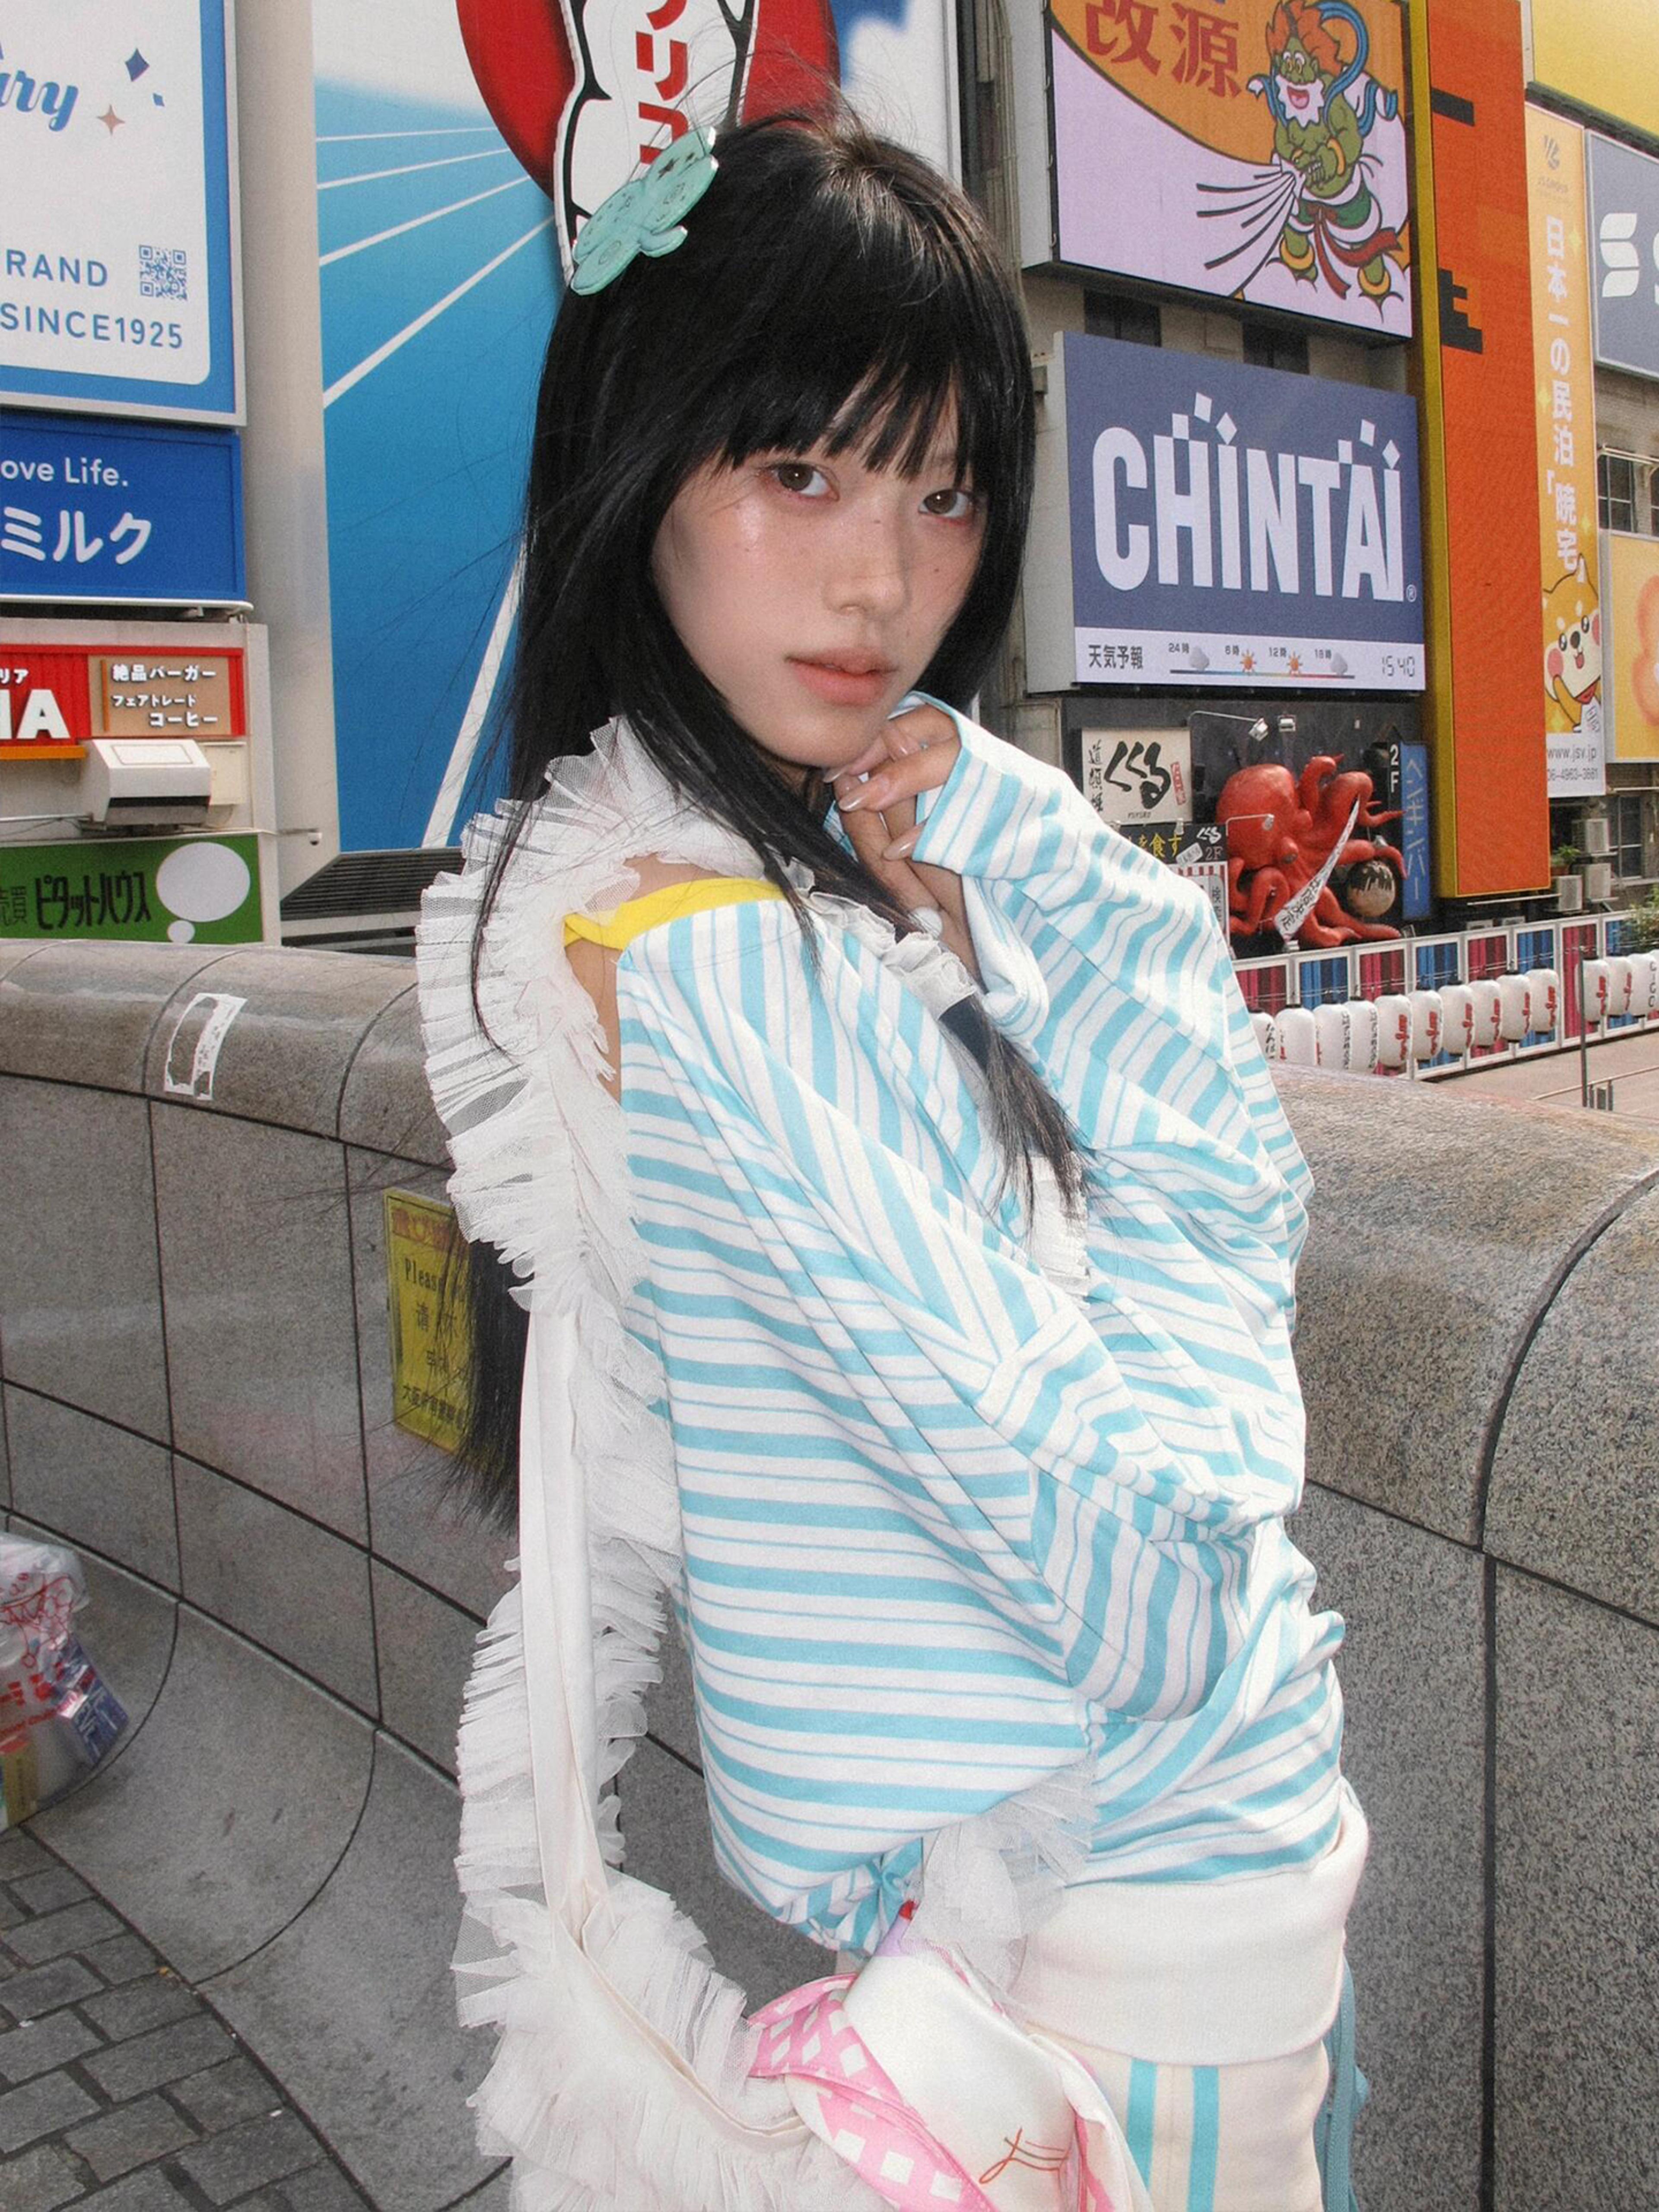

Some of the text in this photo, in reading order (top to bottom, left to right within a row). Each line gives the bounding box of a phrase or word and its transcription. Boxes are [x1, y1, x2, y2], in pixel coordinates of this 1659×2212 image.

[1086, 0, 1242, 98] 改源
[6, 249, 108, 287] RAND
[65, 457, 128, 487] Life.
[1093, 392, 1405, 602] CHINTAI
[1, 506, 151, 565] ミルク
[112, 664, 217, 682] 絶品バーガー
[1088, 645, 1143, 669] 天気予報
[112, 695, 197, 708] フェアトレード
[149, 711, 218, 727] コーヒー
[1103, 741, 1171, 810] くくる
[1390, 744, 1399, 793] 2F
[1205, 846, 1223, 861] 2F
[35, 871, 151, 929] ピタットハウス
